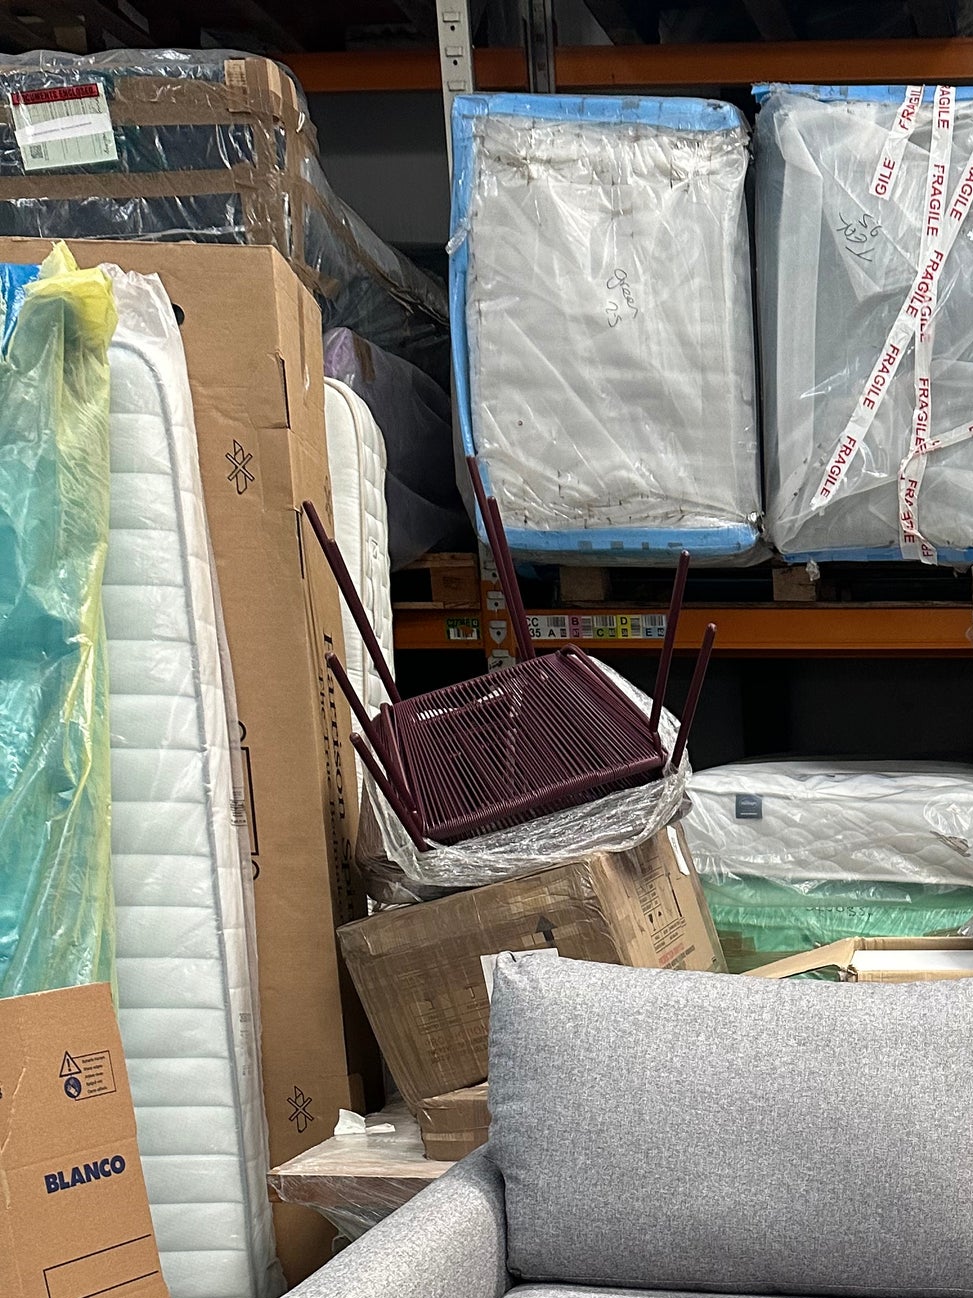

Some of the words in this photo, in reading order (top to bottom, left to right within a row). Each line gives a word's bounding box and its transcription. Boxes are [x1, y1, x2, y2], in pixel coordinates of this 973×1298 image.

[926, 163, 945, 237] FRAGILE
[905, 249, 944, 318] FRAGILE
[863, 344, 901, 411] FRAGILE
[820, 435, 857, 499] FRAGILE
[548, 628, 556, 638] A
[571, 617, 579, 626] B
[596, 628, 604, 638] C
[620, 617, 628, 626] D
[645, 628, 652, 637] E
[44, 1154, 126, 1195] BLANCO
